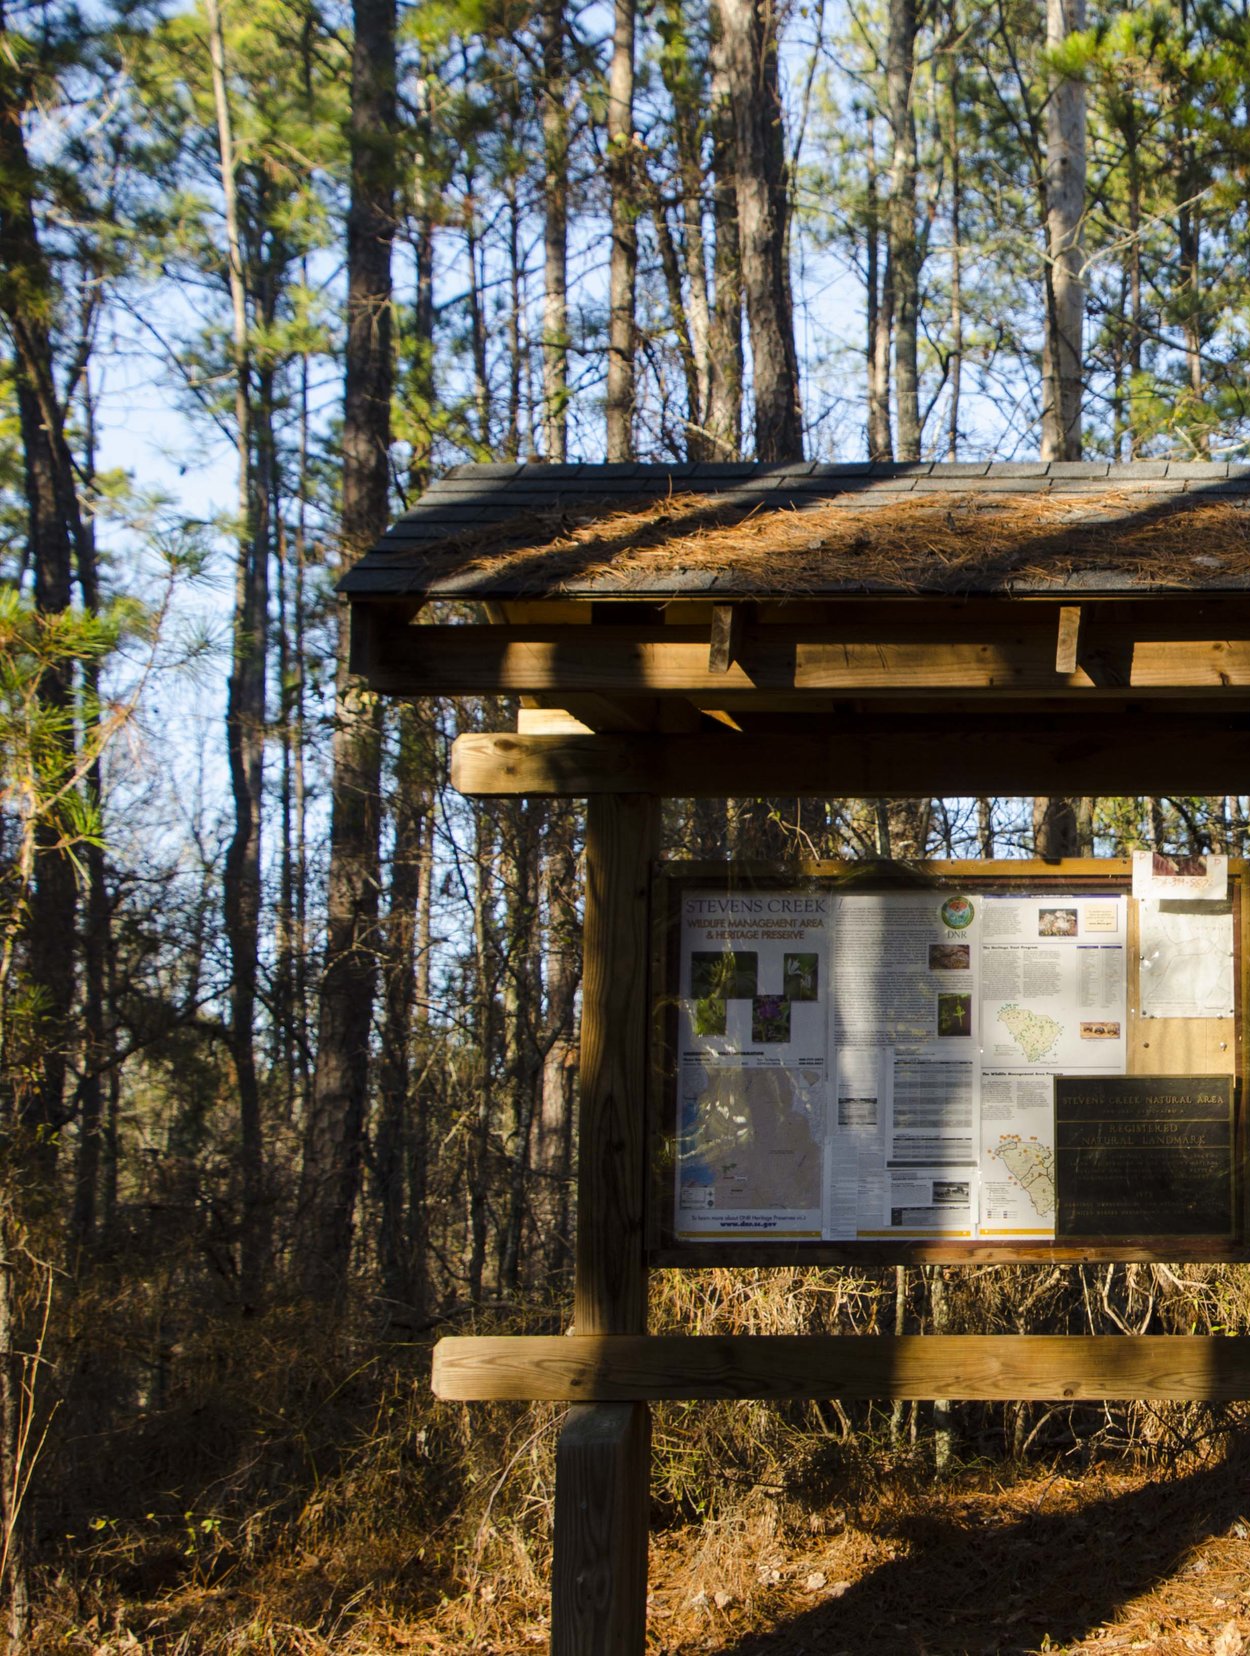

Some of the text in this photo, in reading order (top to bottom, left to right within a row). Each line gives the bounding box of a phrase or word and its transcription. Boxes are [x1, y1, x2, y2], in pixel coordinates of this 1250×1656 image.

[685, 899, 827, 914] STEVENS CREEK
[688, 918, 824, 928] WILDLIFE MANAGEMENT AREA
[706, 930, 805, 940] & HERITAGE PRESERVE
[947, 930, 968, 940] DNR
[1063, 1095, 1224, 1105] STEVENS CREEK NATURAL AREA
[1109, 1123, 1179, 1134] REGISTERED
[1082, 1135, 1206, 1145] NATURAL LANDMARK
[720, 1221, 777, 1229] www.dnr.sc.gov
